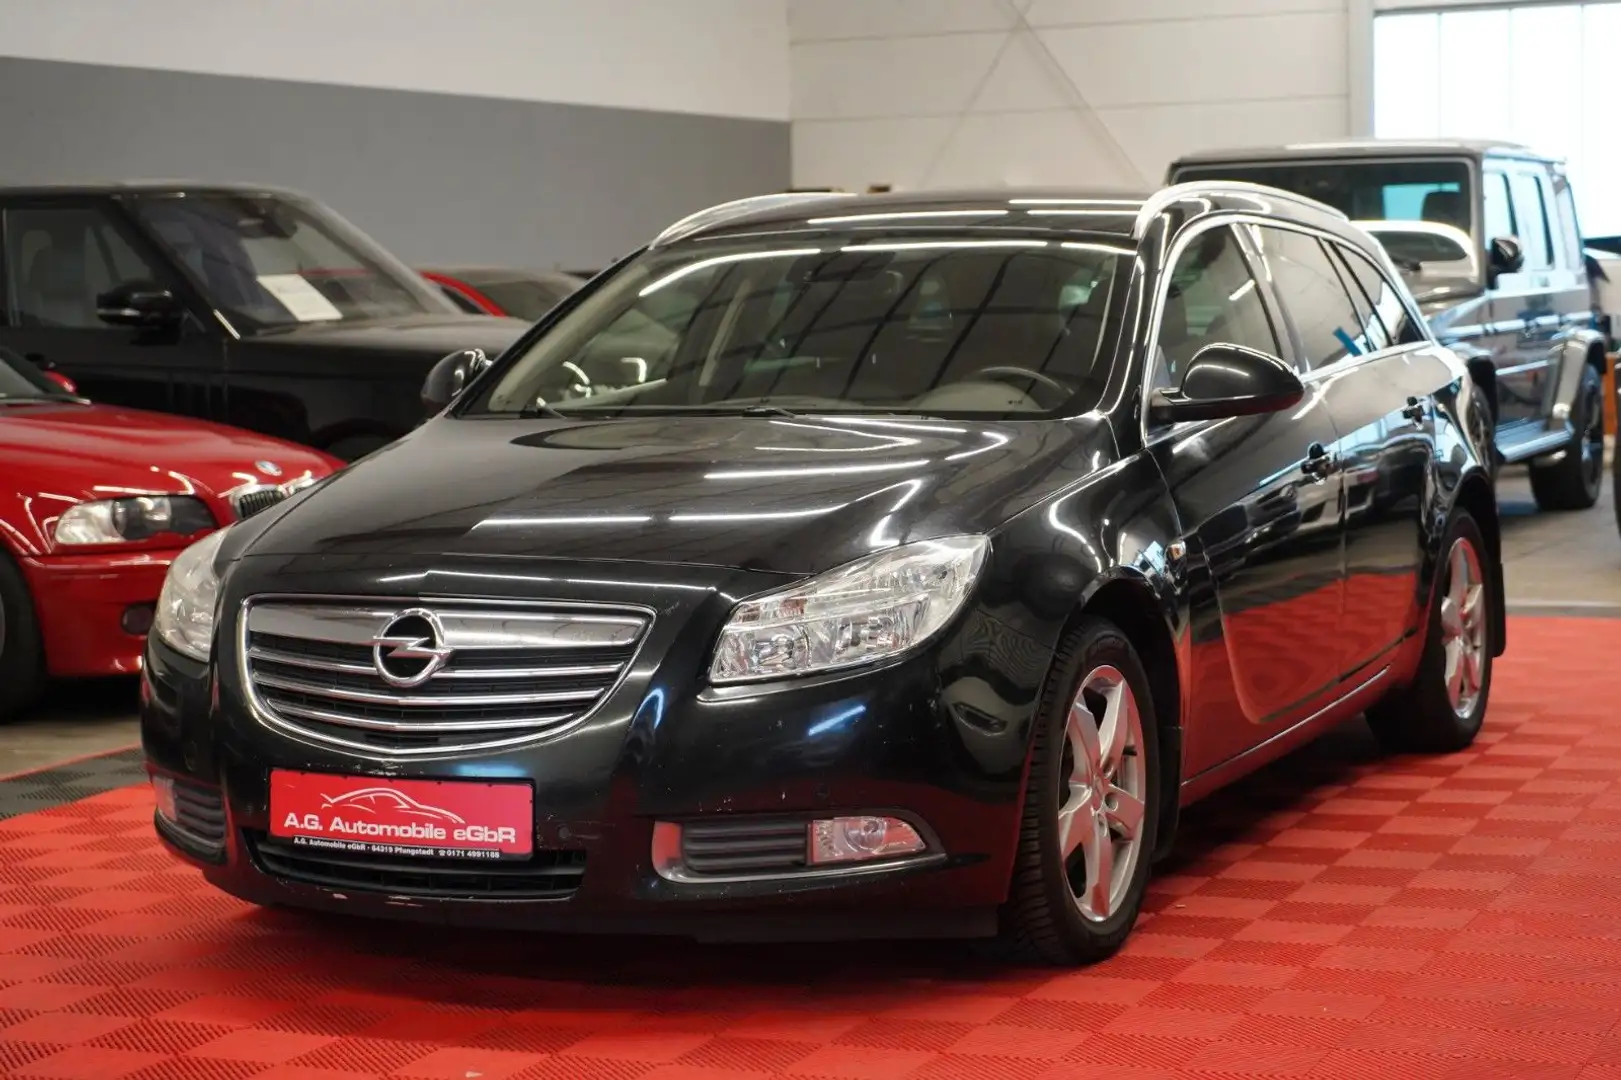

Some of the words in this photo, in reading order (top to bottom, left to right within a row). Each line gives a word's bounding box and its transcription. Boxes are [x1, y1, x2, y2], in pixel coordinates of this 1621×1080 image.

[284, 812, 323, 831] A.G.
[329, 816, 446, 840] Automobile
[453, 825, 516, 844] eGbR
[309, 839, 346, 849] Automobile
[347, 842, 366, 851] eGbR
